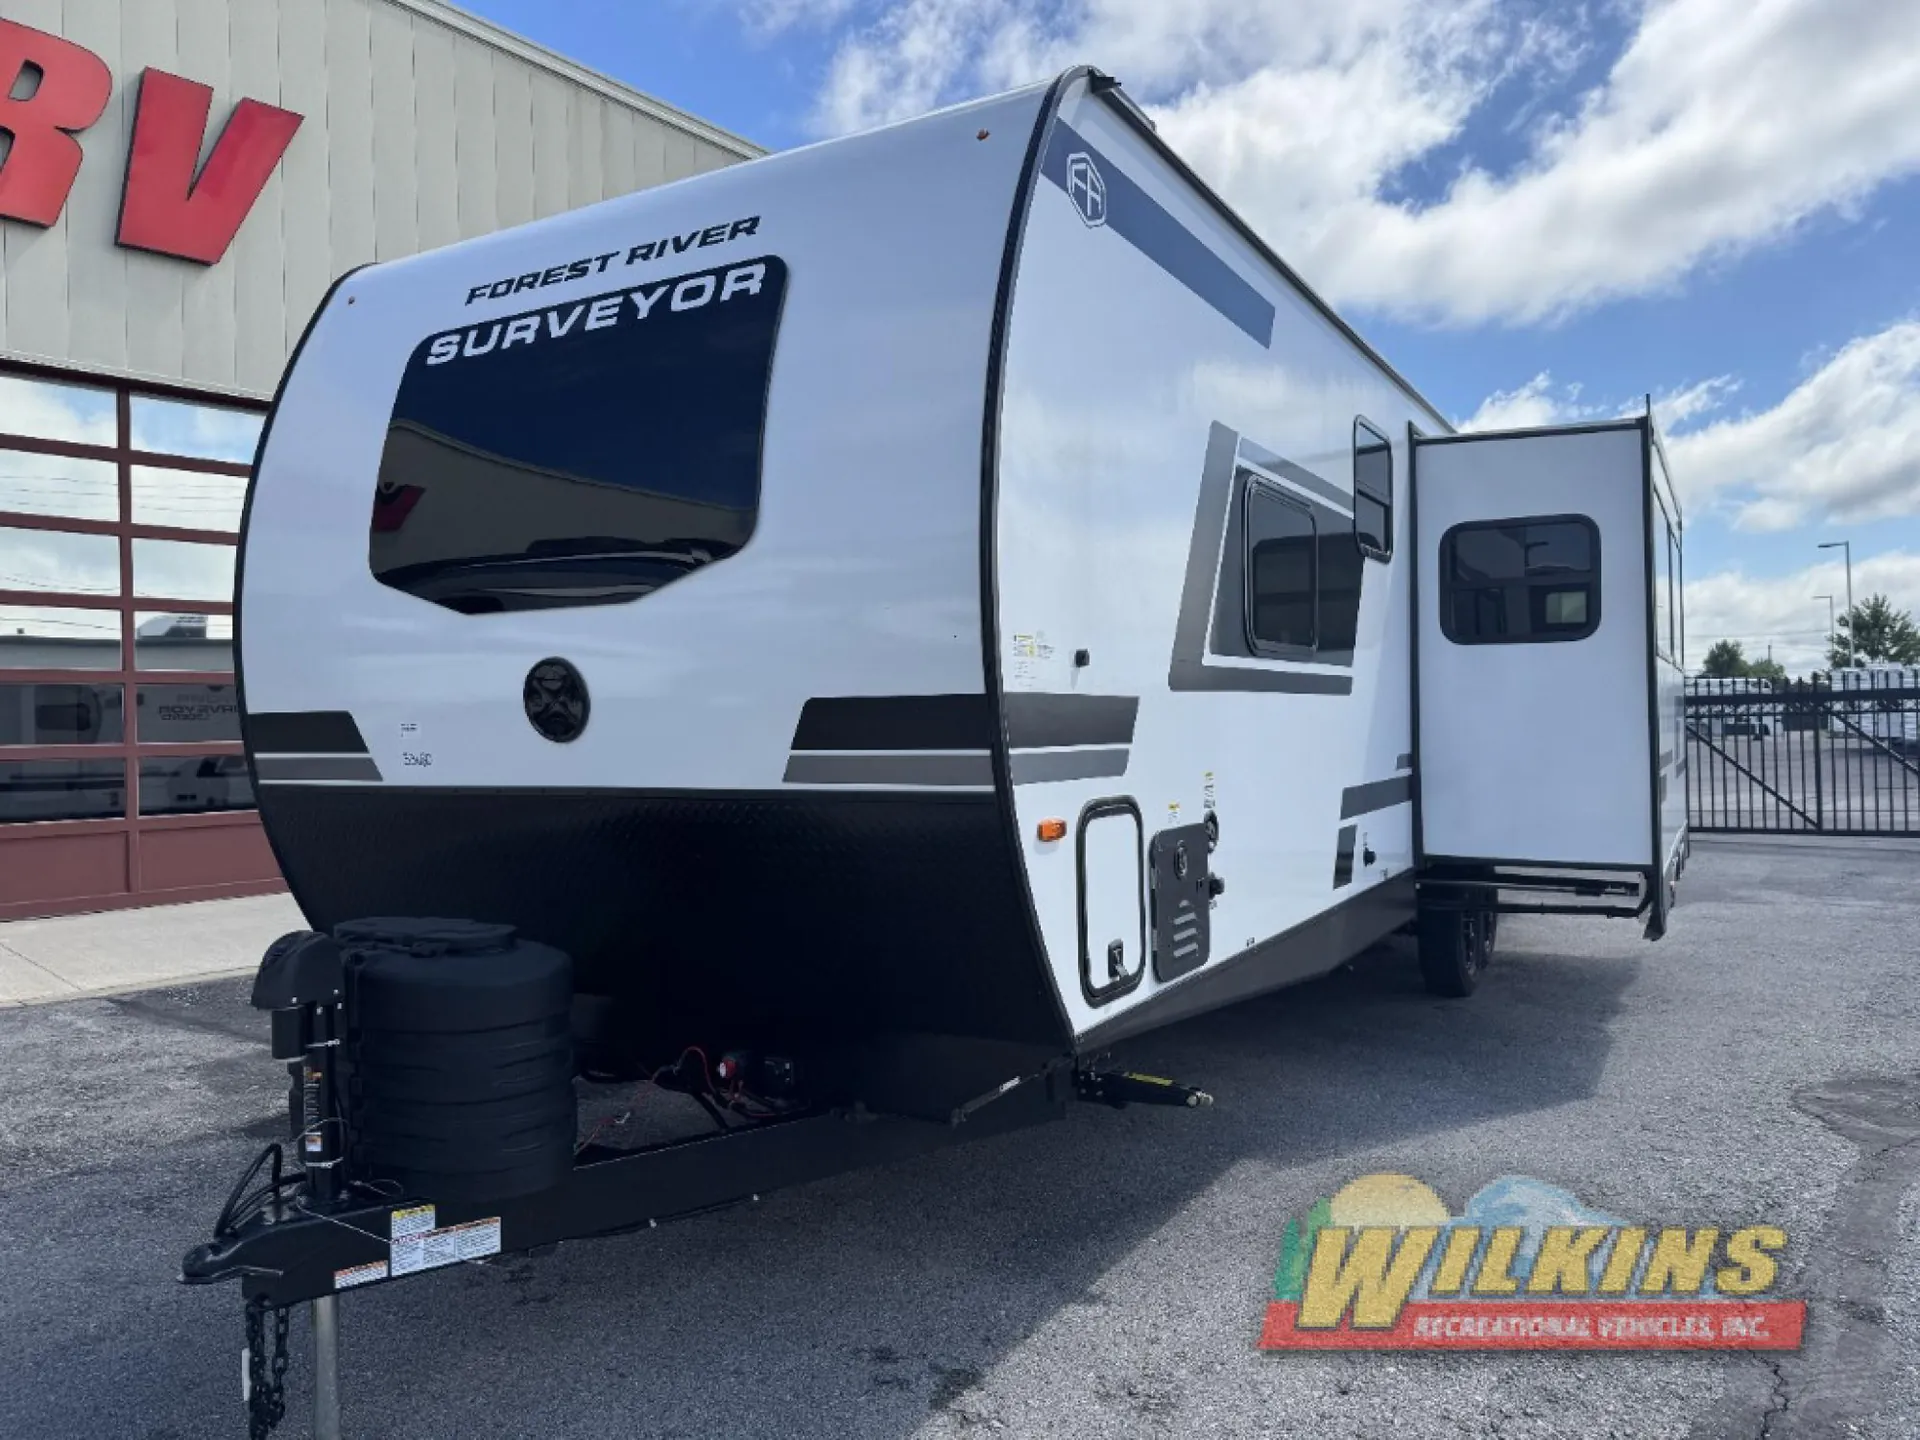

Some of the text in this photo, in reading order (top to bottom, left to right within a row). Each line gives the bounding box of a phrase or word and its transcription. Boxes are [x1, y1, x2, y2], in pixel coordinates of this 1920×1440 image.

[0, 17, 305, 266] RV
[465, 215, 761, 306] FOREST RIVER
[426, 263, 766, 366] SURVEYOR
